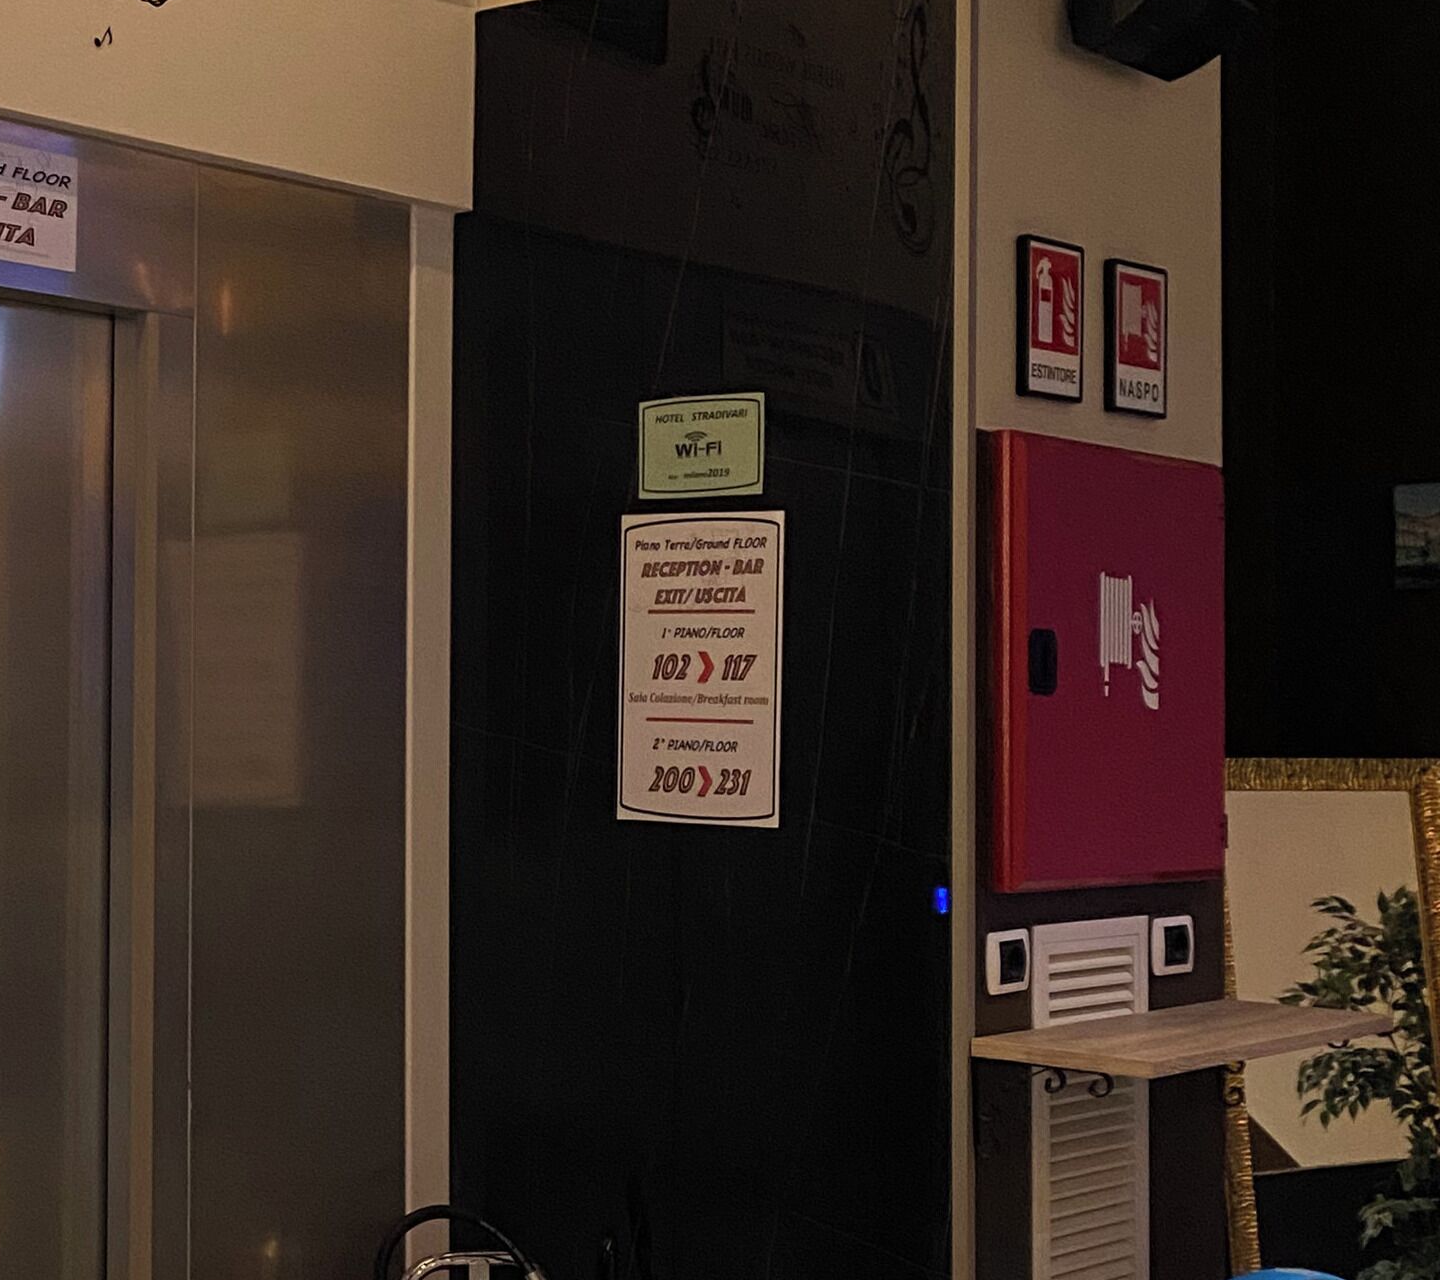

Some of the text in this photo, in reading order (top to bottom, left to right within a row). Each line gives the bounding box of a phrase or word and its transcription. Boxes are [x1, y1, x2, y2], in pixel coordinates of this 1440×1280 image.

[11, 166, 72, 190] FLOOR
[11, 192, 68, 218] BAR
[1031, 362, 1077, 384] ESTINTORE
[1119, 378, 1159, 403] NASPO
[655, 408, 748, 424] HOTEL STRADIVARI
[635, 536, 767, 551] Piano Terra/Ground FLOOR
[641, 560, 723, 578] RECEPTION
[732, 558, 764, 575] BAR
[654, 586, 747, 605] EXIT/ USCITA
[673, 627, 745, 639] PIANO/FLOOR
[652, 653, 757, 681] 102 117
[667, 739, 738, 752] PIANO/FLOOR
[648, 766, 752, 796] 200 231
